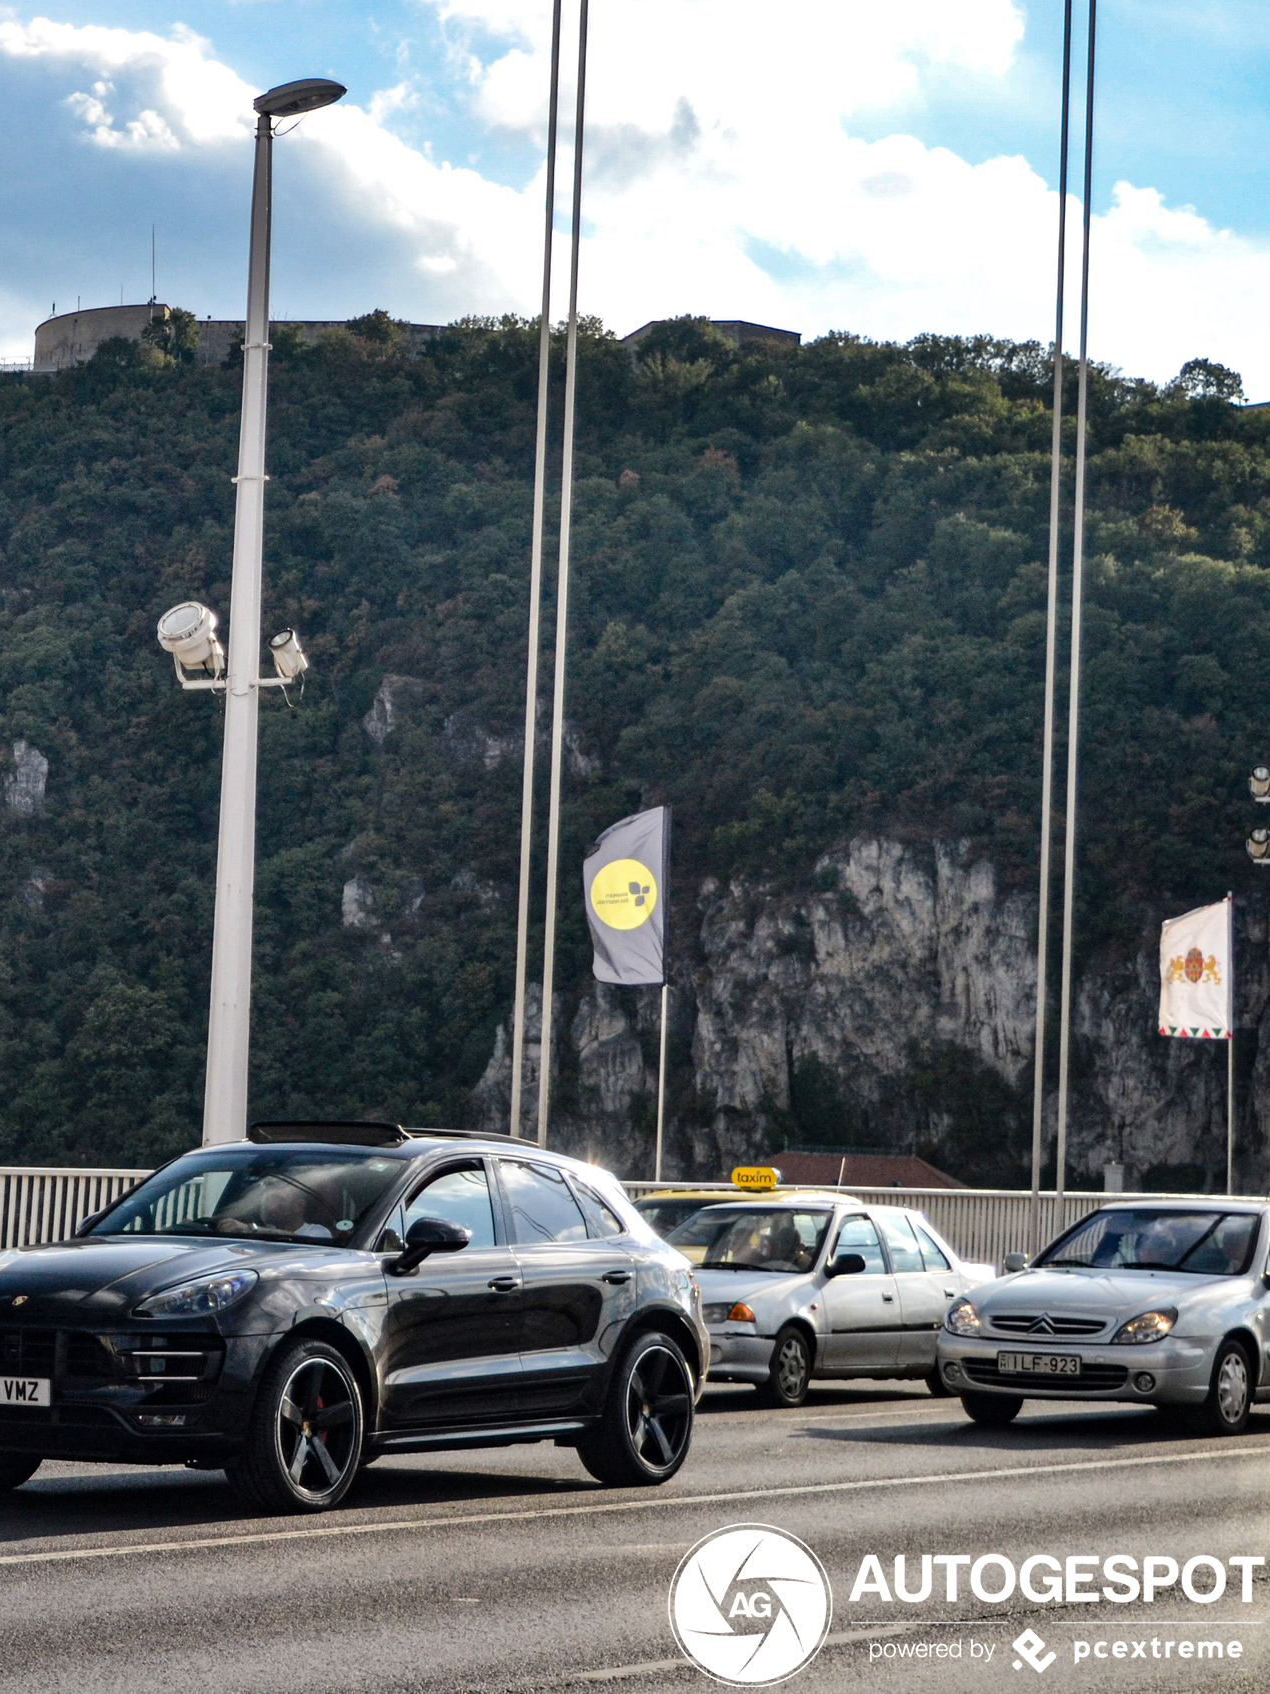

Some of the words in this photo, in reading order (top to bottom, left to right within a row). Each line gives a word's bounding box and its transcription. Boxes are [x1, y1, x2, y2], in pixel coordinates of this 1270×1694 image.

[737, 1170, 772, 1183] taxim
[1013, 1354, 1078, 1373] ILF-923
[3, 1380, 39, 1402] VMZ
